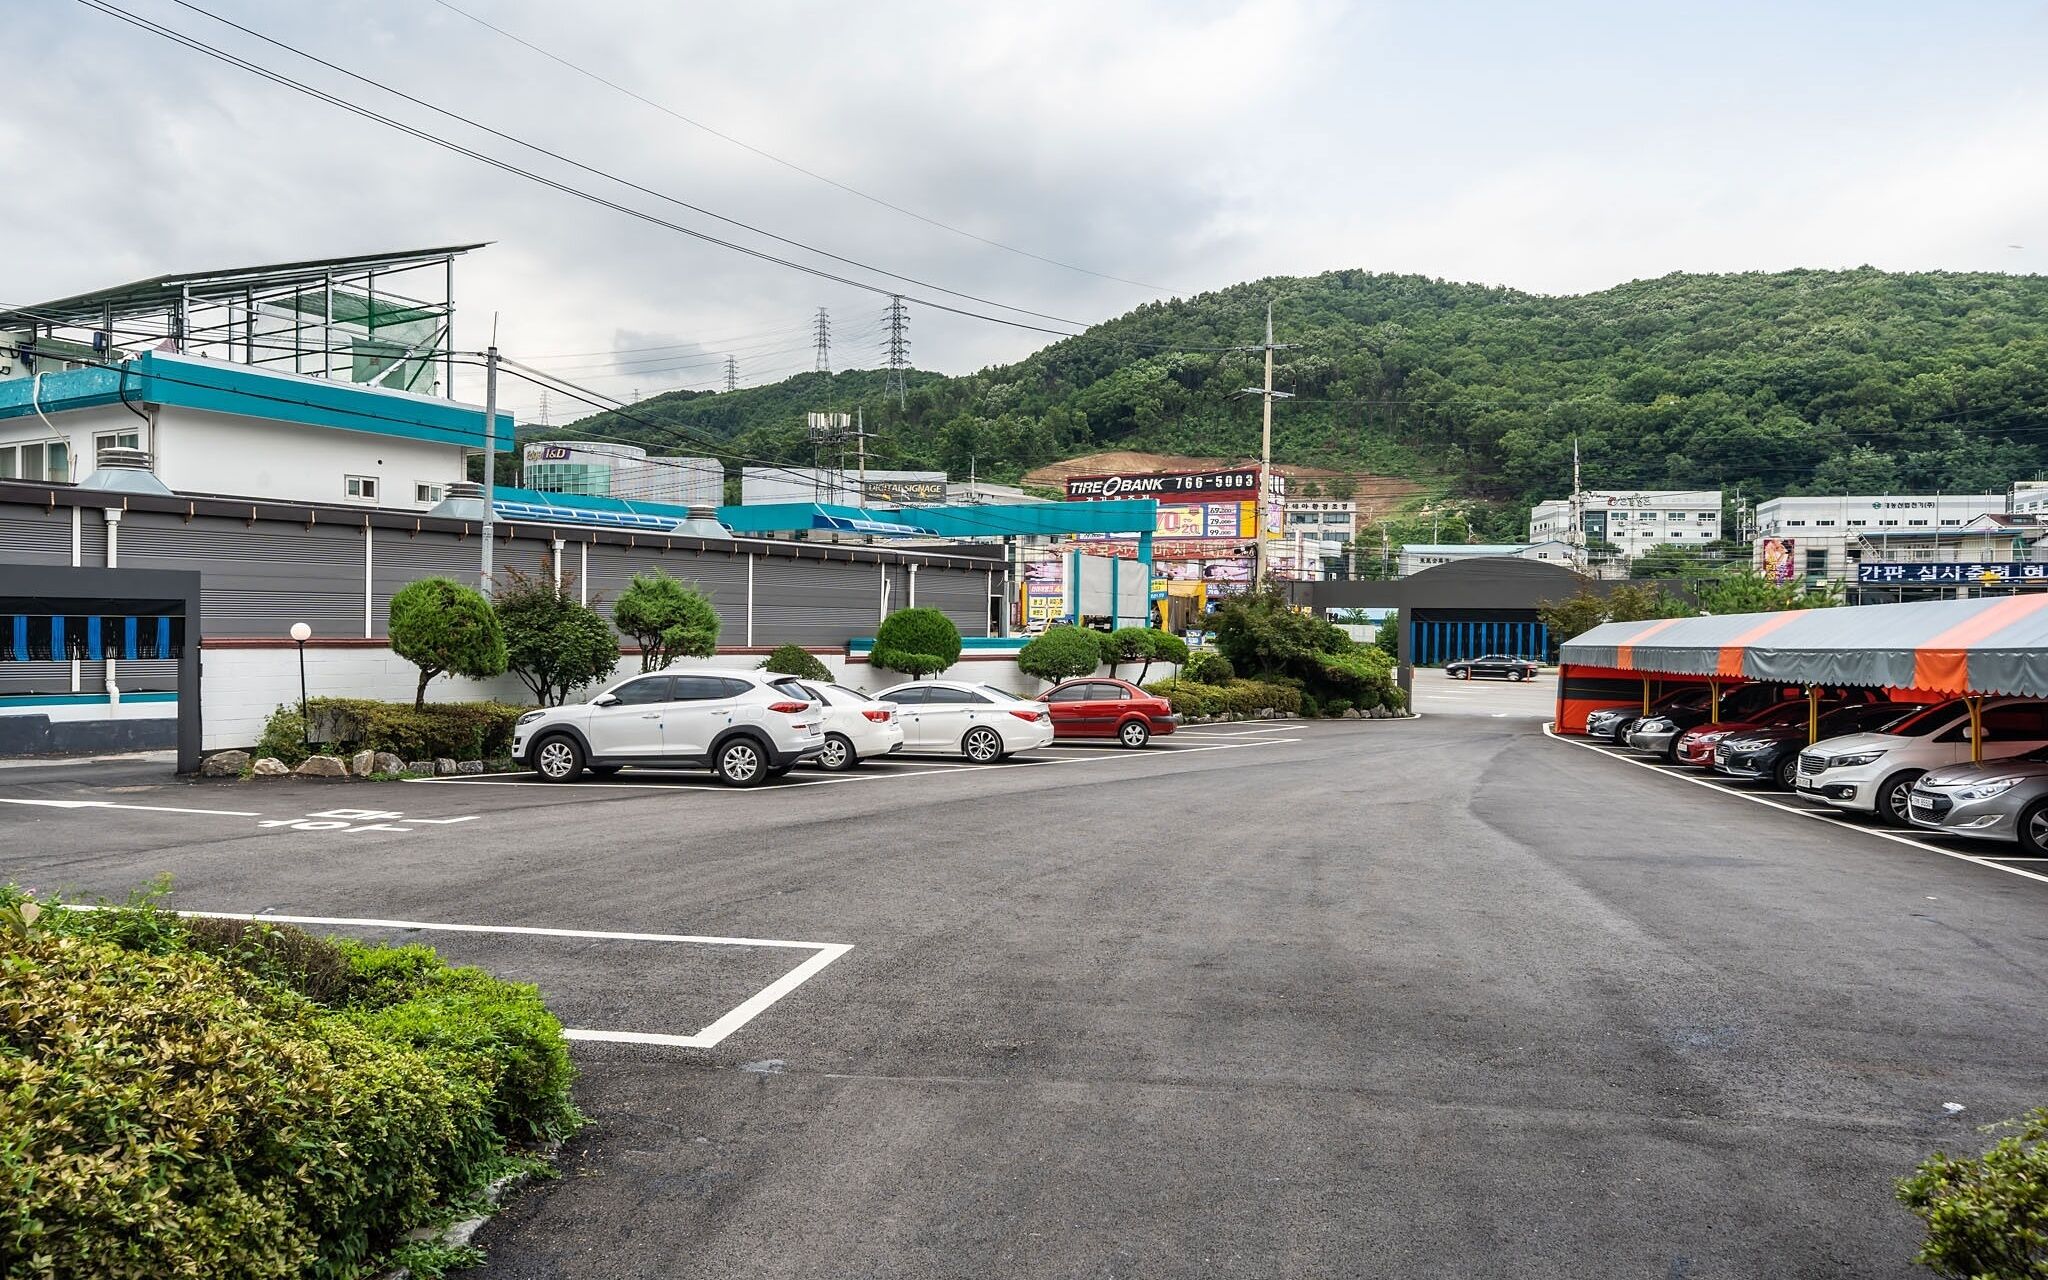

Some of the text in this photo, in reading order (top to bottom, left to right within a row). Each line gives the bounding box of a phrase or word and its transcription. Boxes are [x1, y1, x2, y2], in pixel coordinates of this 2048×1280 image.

[545, 448, 566, 459] I&D
[1175, 474, 1253, 489] 766-5003
[868, 483, 942, 493] DIGITAL SIGNAGE
